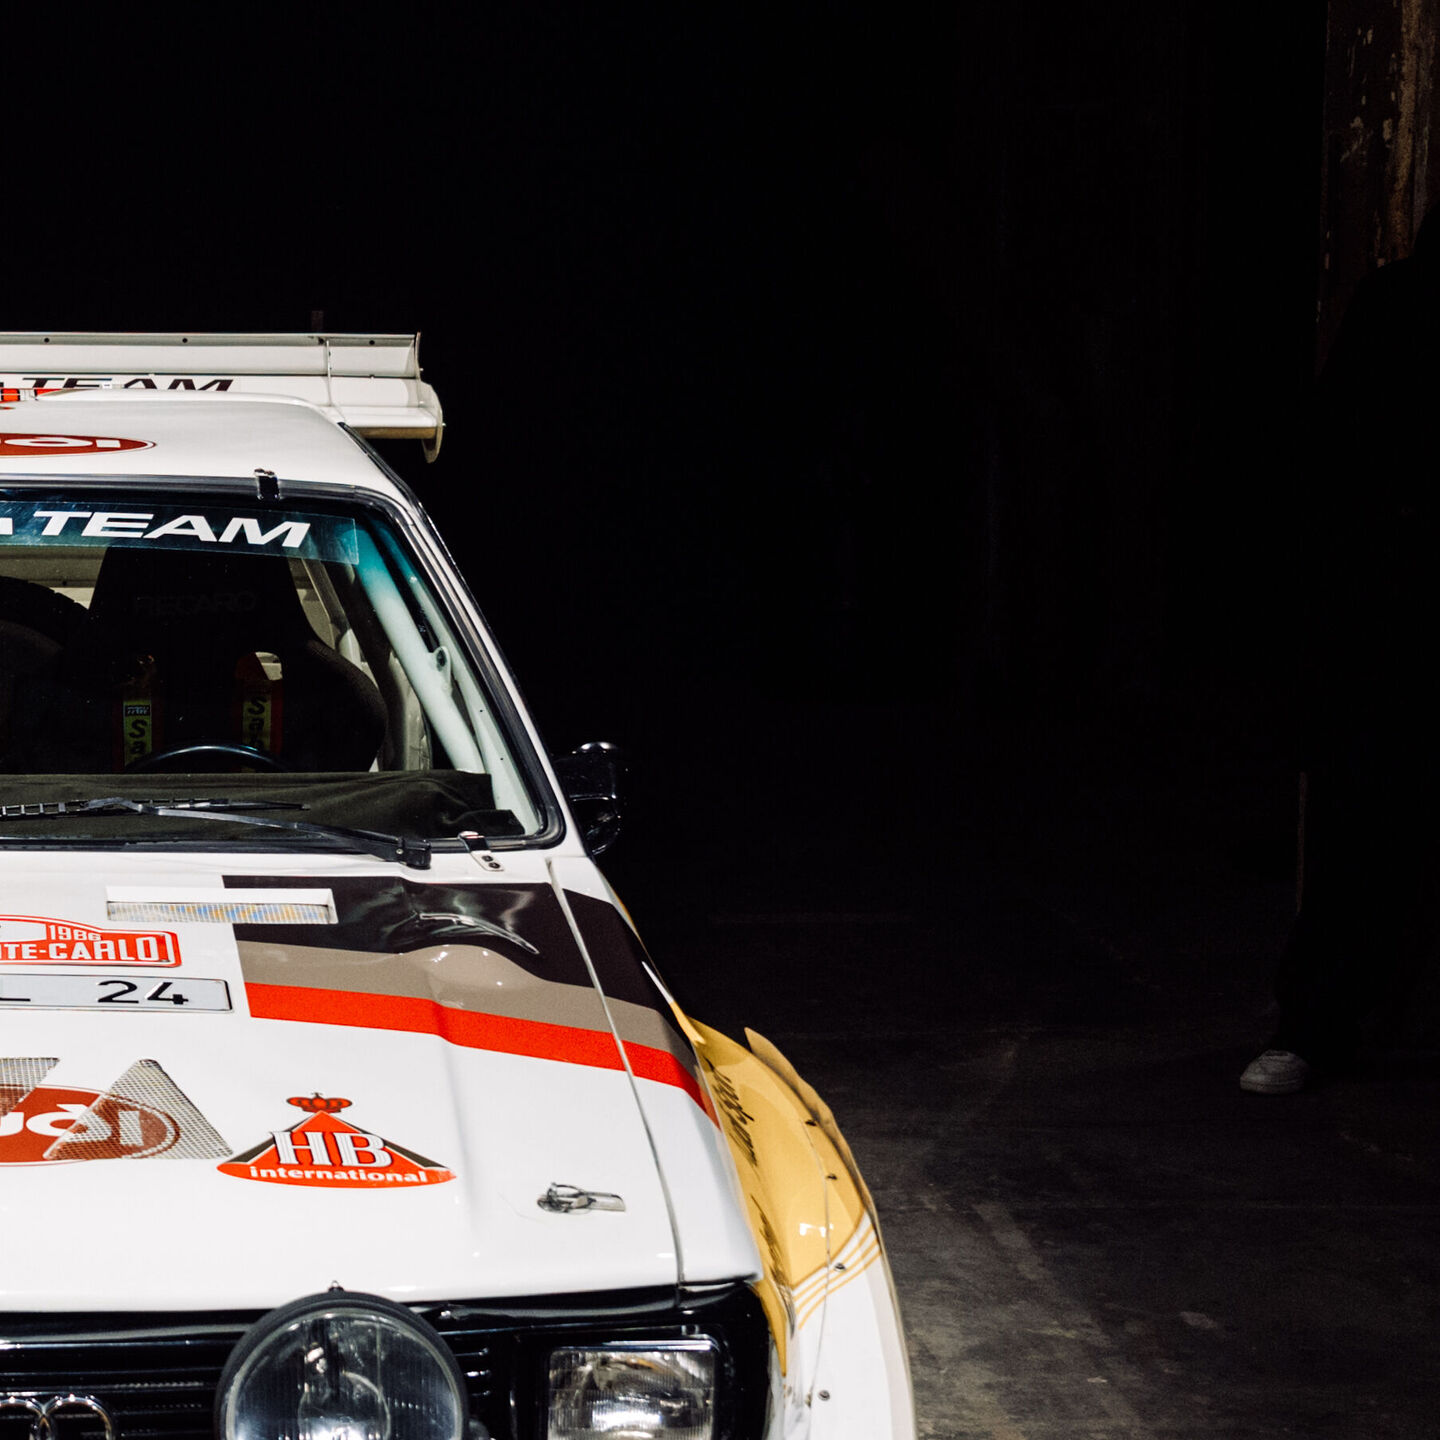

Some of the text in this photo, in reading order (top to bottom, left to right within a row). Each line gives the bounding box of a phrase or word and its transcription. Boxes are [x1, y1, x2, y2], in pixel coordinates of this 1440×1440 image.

[33, 511, 310, 548] TEAM
[48, 924, 102, 942] 1986
[97, 980, 189, 1006] 24
[270, 1131, 393, 1169] HB
[249, 1165, 428, 1183] international
